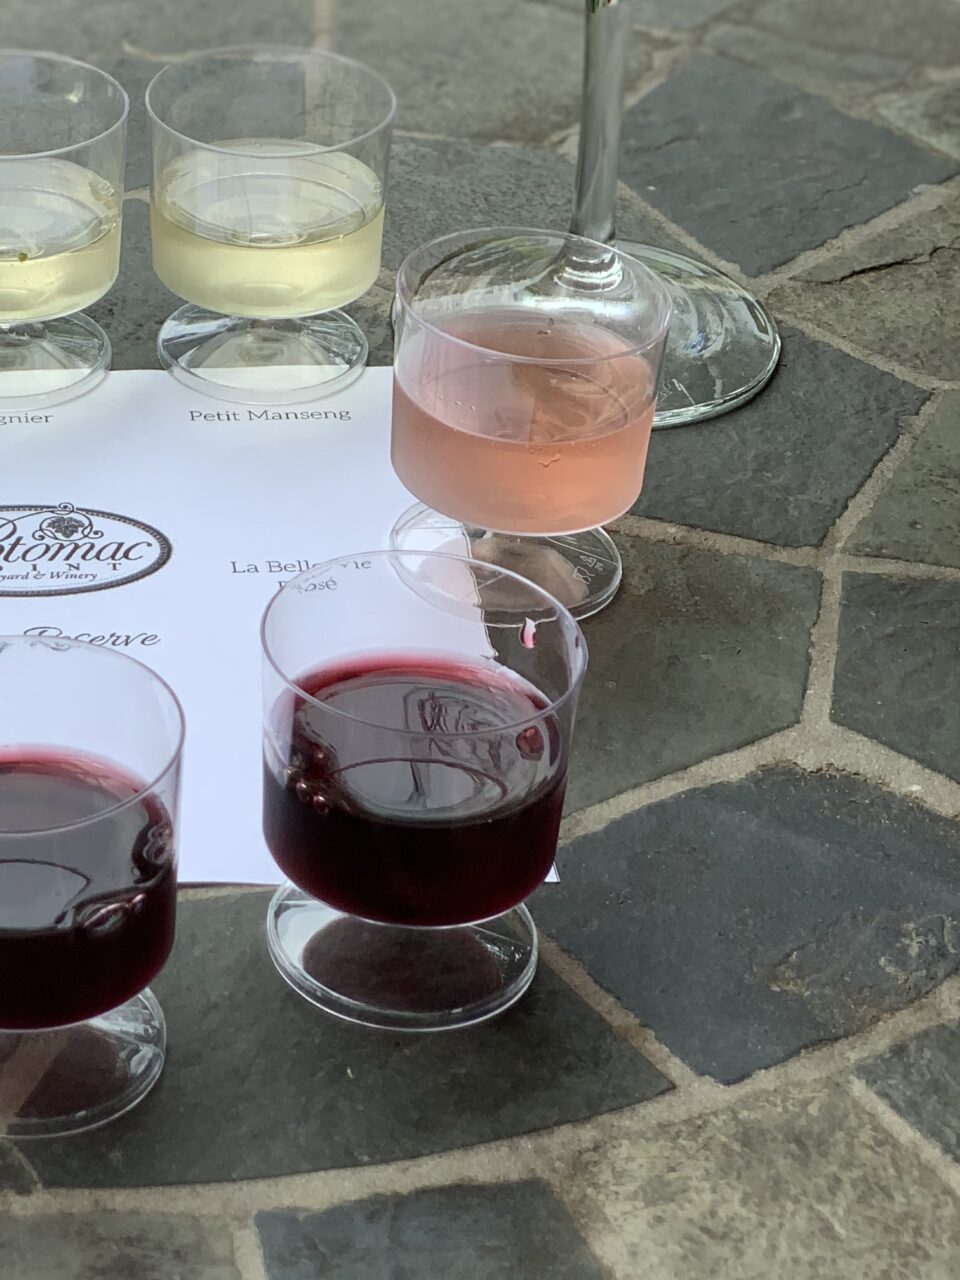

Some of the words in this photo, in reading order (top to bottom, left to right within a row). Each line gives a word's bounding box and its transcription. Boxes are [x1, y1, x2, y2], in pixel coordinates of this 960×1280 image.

[189, 410, 241, 421] Petit
[247, 409, 352, 421] Manseng
[230, 560, 259, 574] La
[33, 570, 46, 580] &
[50, 571, 98, 582] Winery
